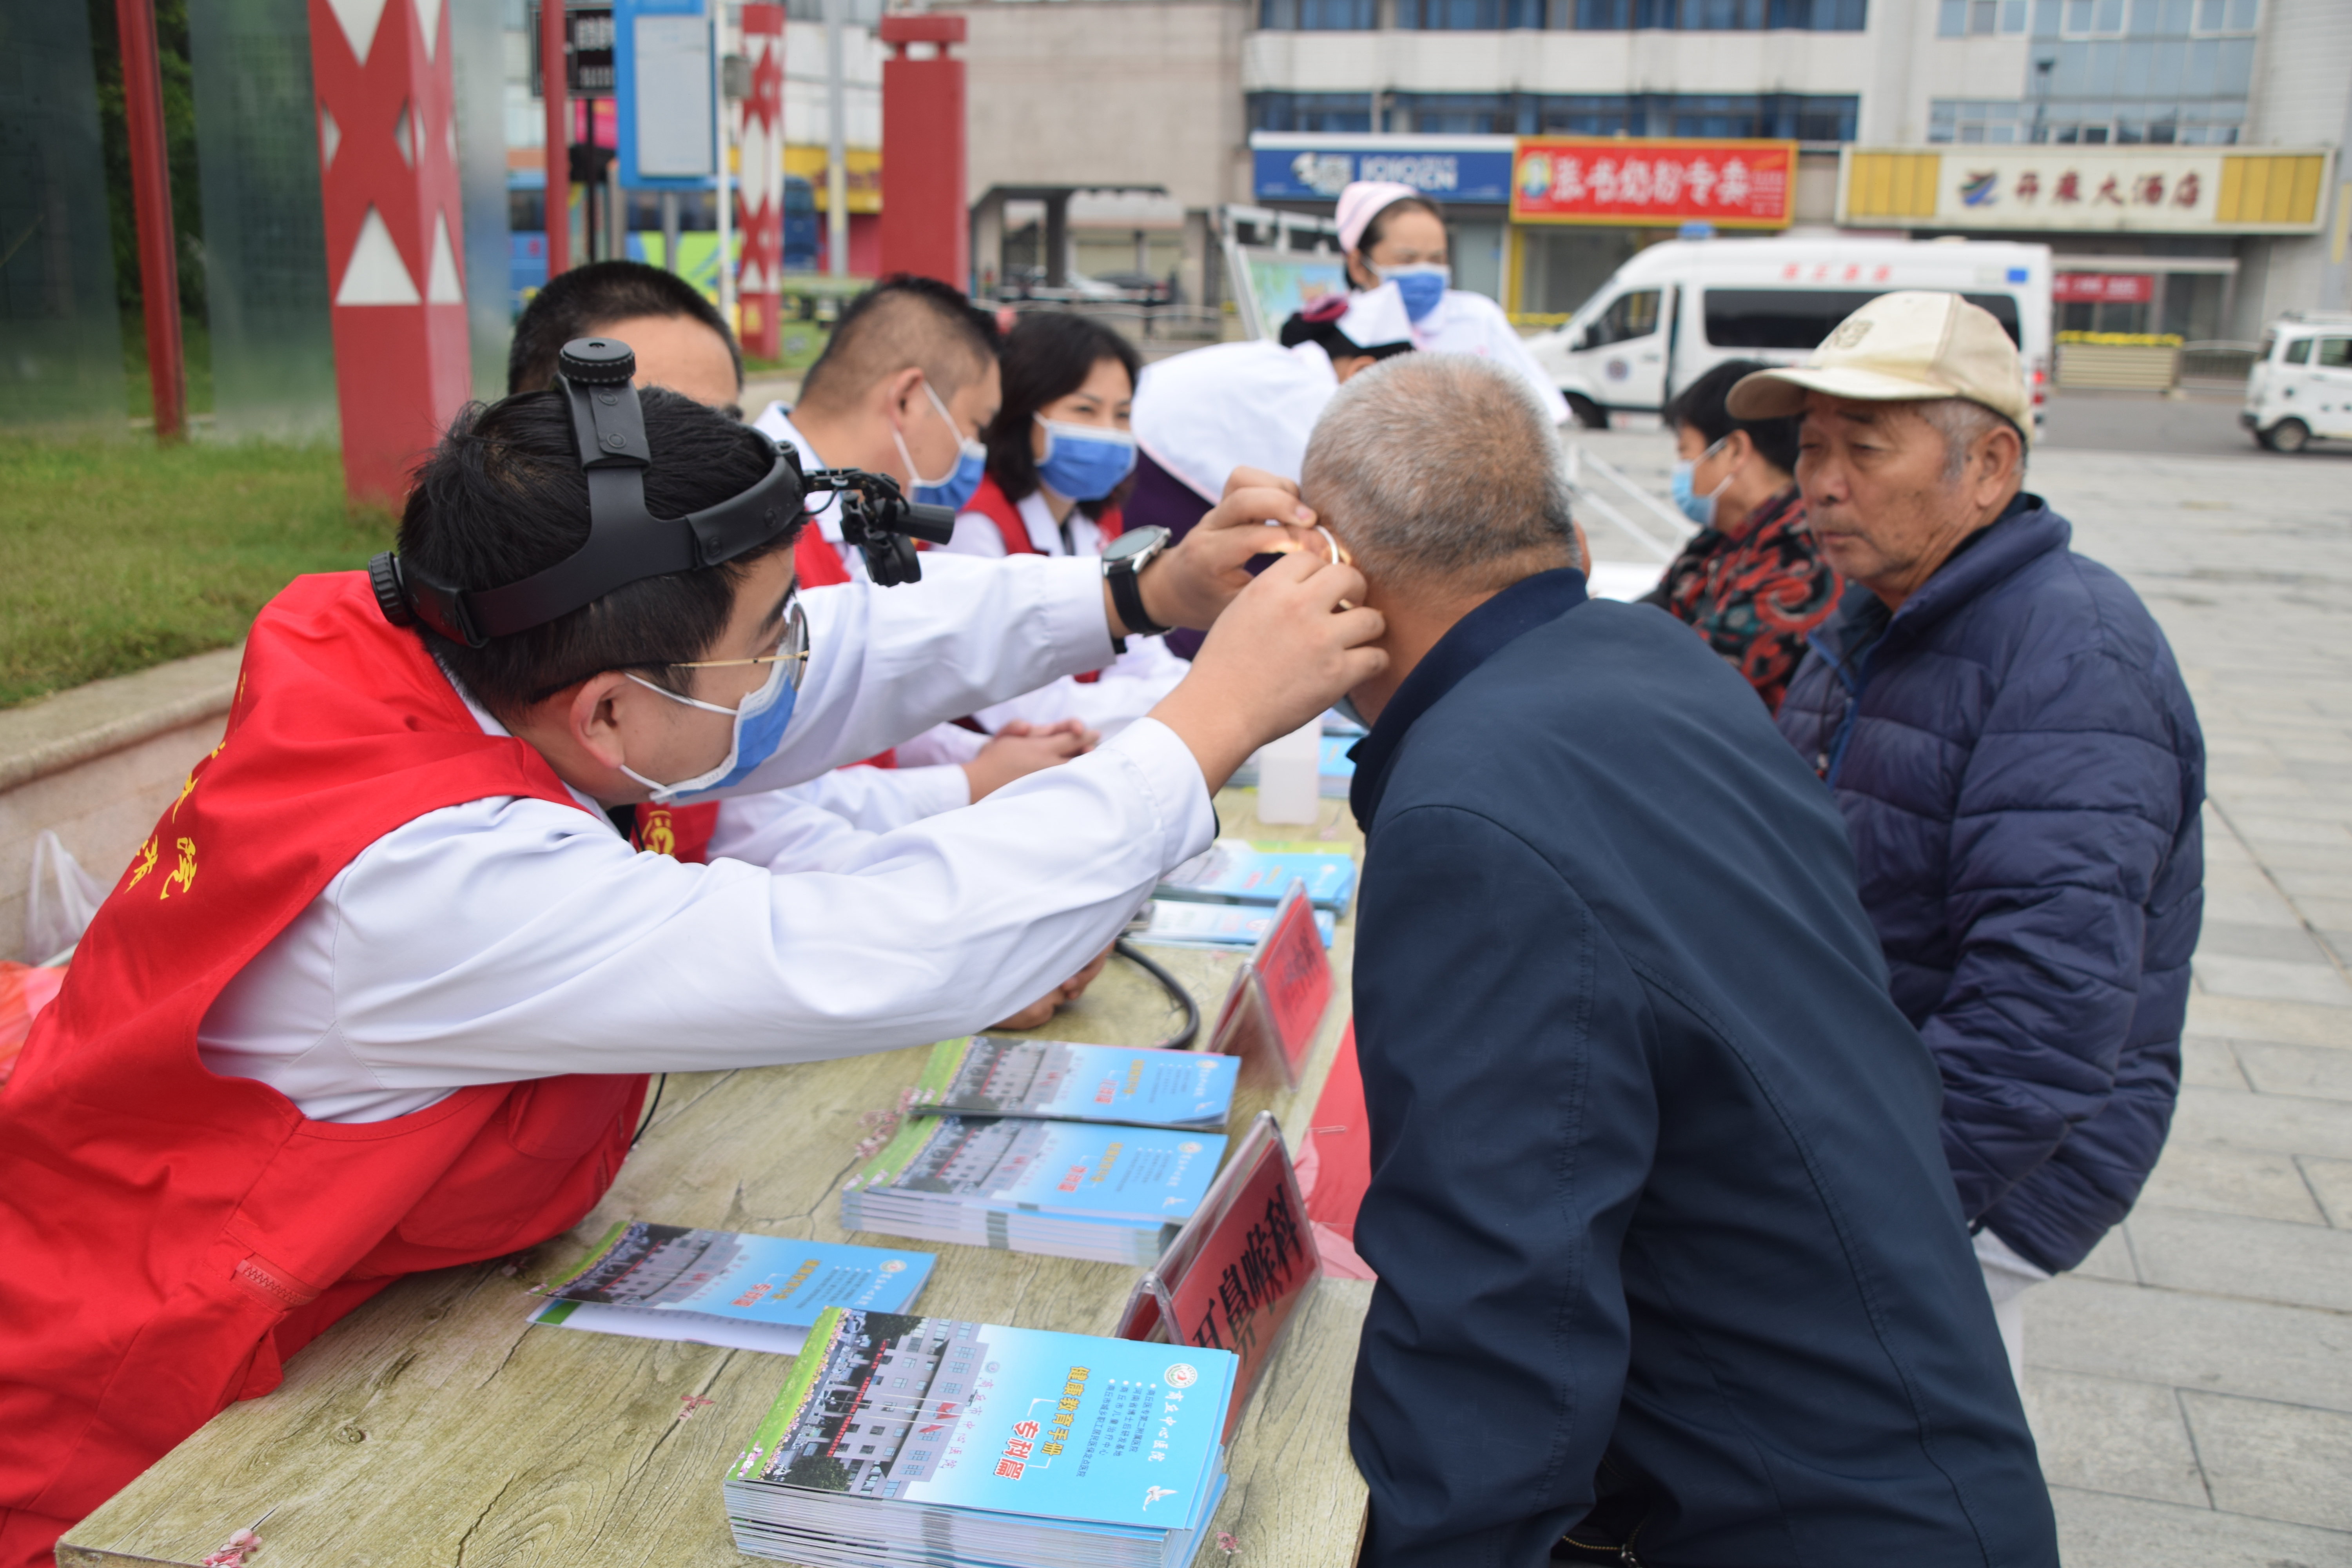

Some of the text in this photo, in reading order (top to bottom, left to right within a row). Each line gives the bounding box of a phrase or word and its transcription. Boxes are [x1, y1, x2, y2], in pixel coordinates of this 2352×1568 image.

[1038, 1365, 1093, 1457] 健康教育手册
[1098, 1386, 1129, 1456] 商丘市儿童治疗中心
[1112, 1387, 1143, 1457] 河南省博士后研发基地
[1128, 1389, 1156, 1453] 商丘医专第二附属医院
[1146, 1389, 1185, 1463] 商丘中心医院
[990, 1417, 1044, 1481] 专科篇
